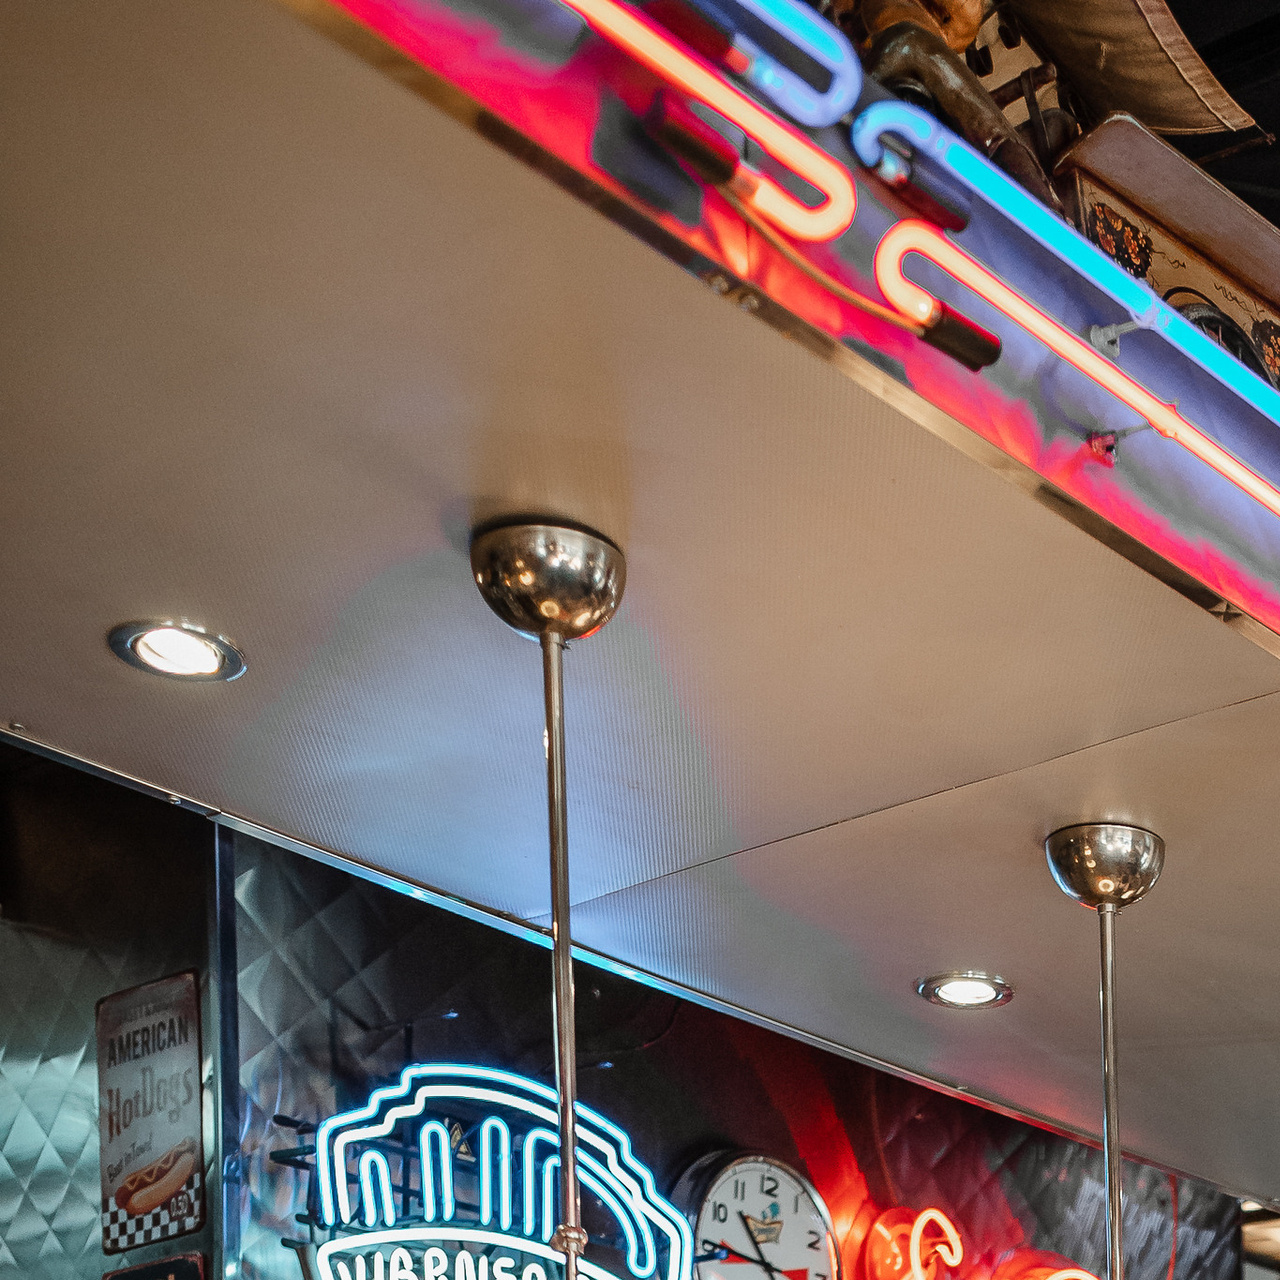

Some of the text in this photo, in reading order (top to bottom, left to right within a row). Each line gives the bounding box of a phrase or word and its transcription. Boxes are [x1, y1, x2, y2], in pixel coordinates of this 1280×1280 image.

[107, 1016, 189, 1068] AMERICAN
[733, 1179, 746, 1201] 11
[760, 1174, 779, 1198] 12
[711, 1201, 728, 1223] 10
[806, 1230, 821, 1250] 2
